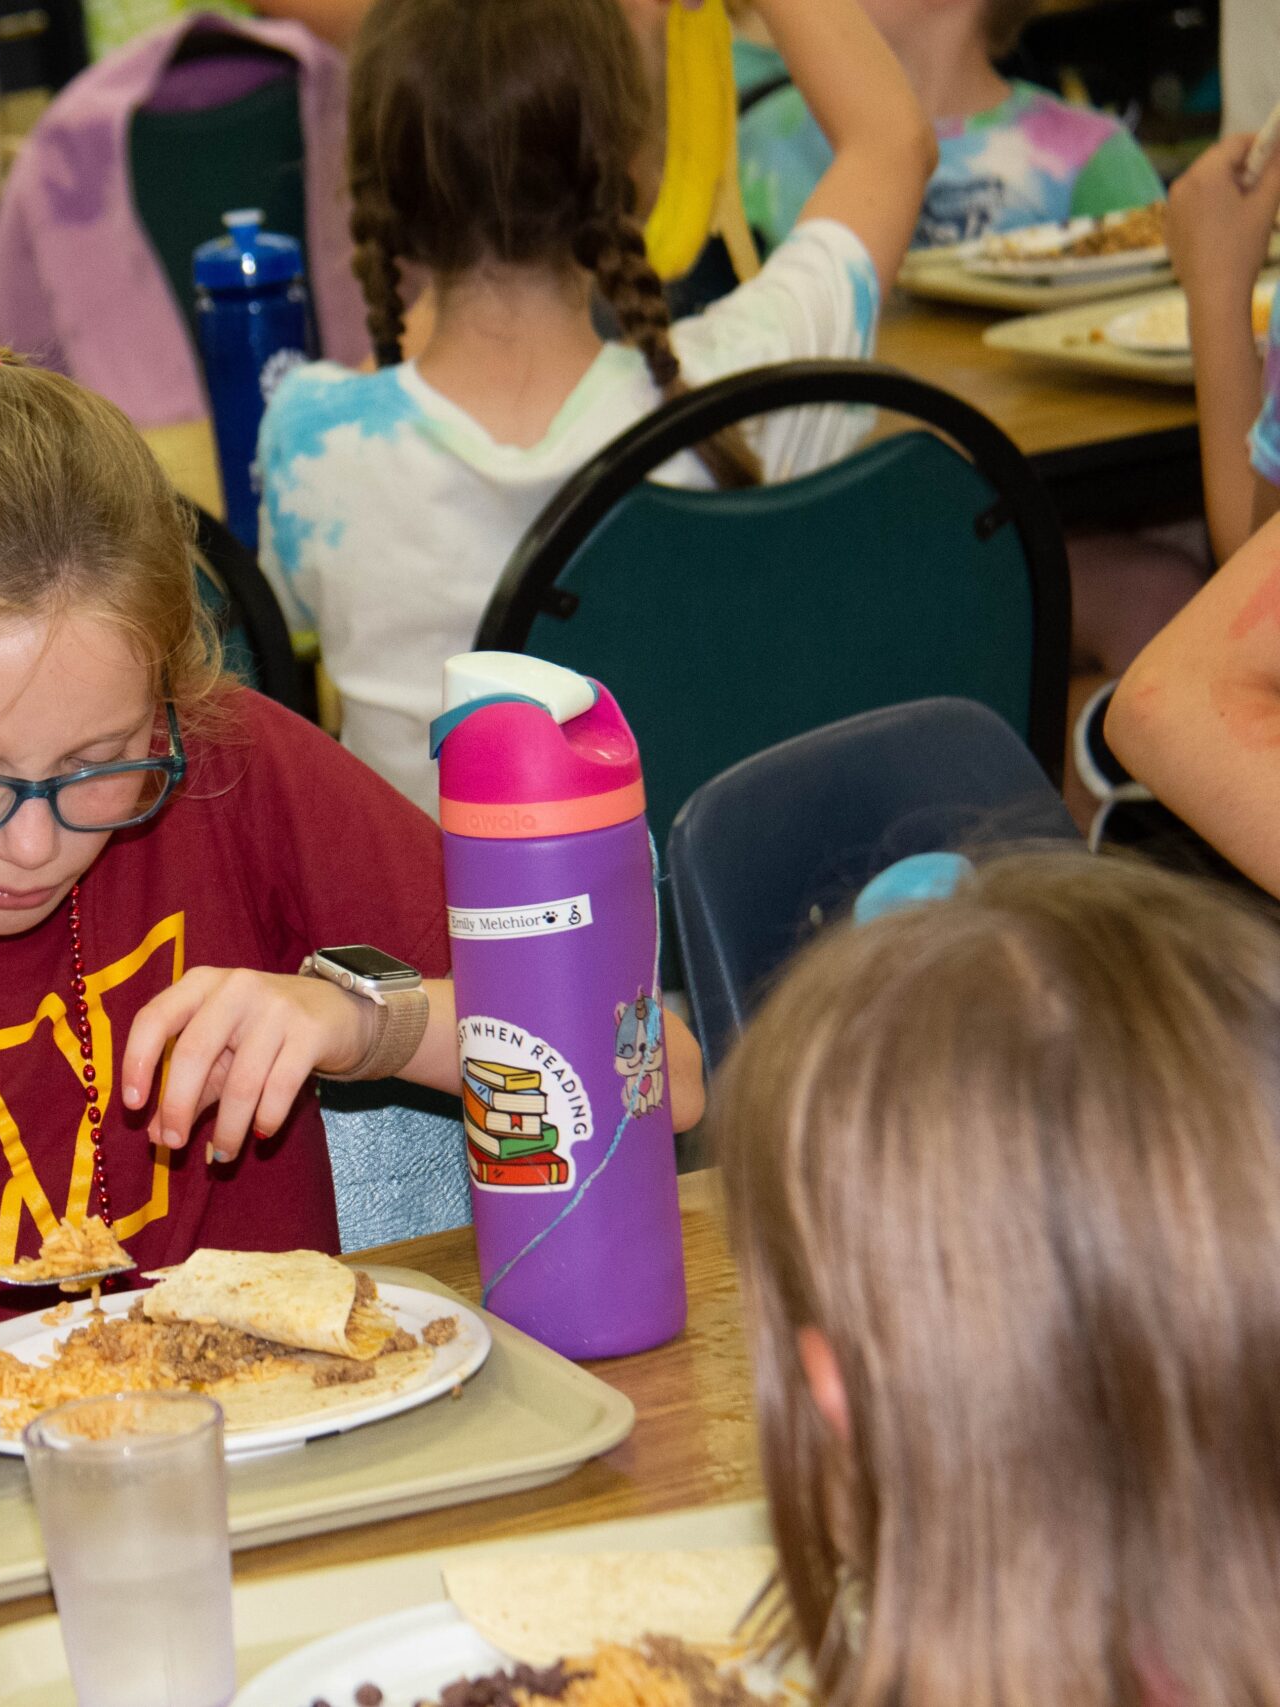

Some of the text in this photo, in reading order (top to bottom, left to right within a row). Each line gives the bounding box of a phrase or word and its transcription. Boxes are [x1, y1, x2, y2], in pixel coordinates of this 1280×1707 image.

[451, 915, 542, 933] Emily Melchior
[471, 1023, 523, 1047] WHEN
[530, 1045, 587, 1134] READING
